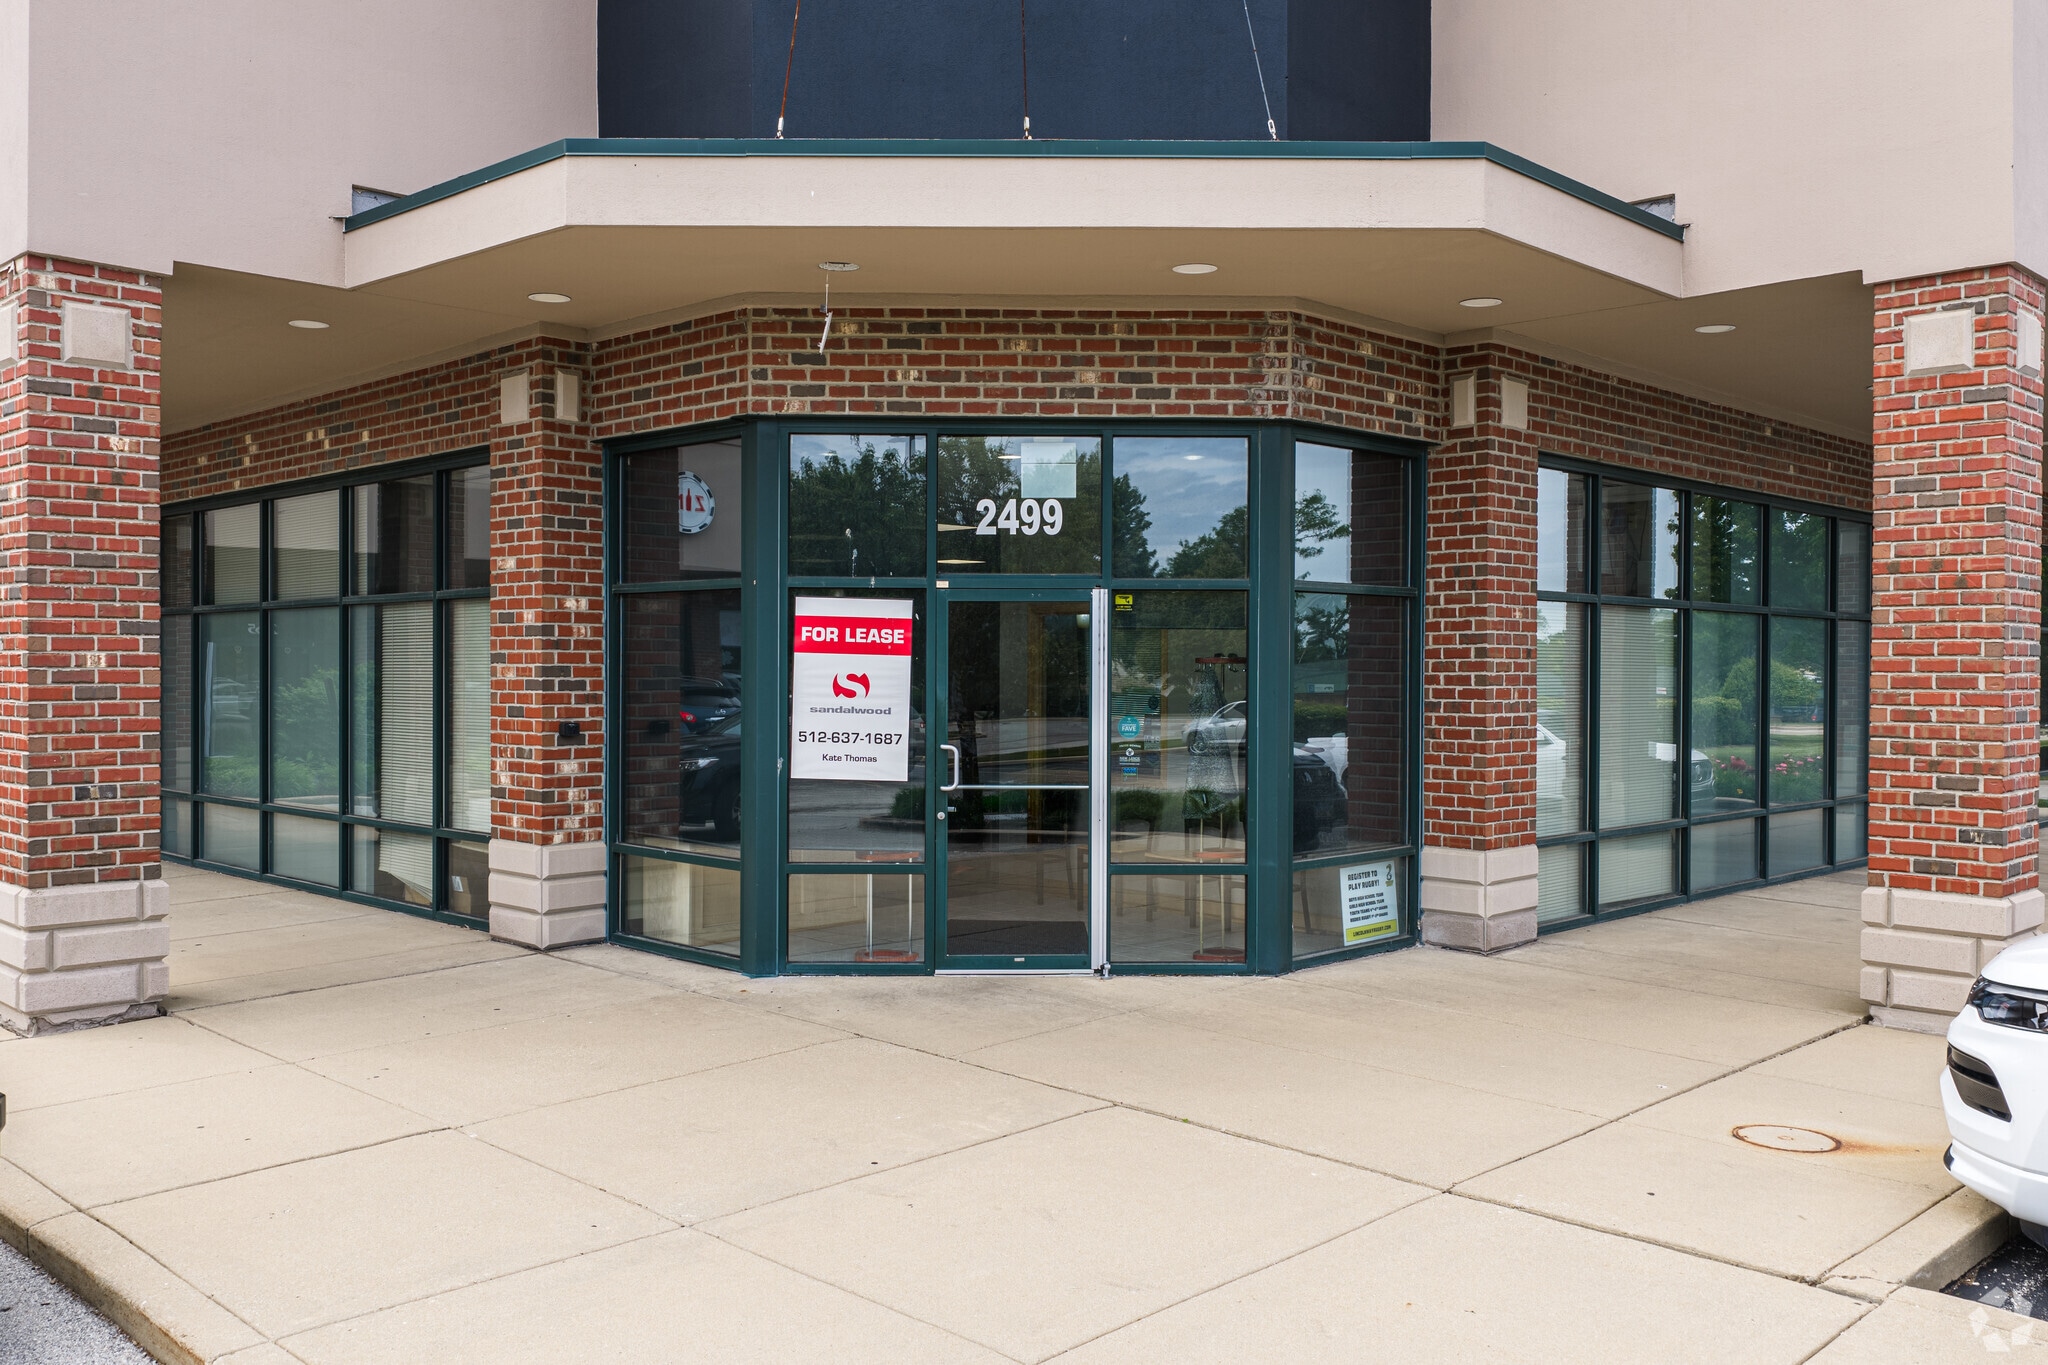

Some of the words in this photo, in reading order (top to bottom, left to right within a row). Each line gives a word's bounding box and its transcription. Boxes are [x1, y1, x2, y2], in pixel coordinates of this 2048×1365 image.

[976, 498, 1063, 535] 2499
[801, 626, 838, 642] FOR
[845, 628, 904, 644] LEASE
[810, 706, 892, 715] sandalwood
[798, 731, 902, 744] 512-637-1687
[822, 754, 842, 762] Kate
[844, 754, 878, 762] Thomas
[1348, 871, 1371, 880] REGISTER
[1348, 882, 1361, 890] PLAY
[1362, 879, 1379, 888] RUGBY!
